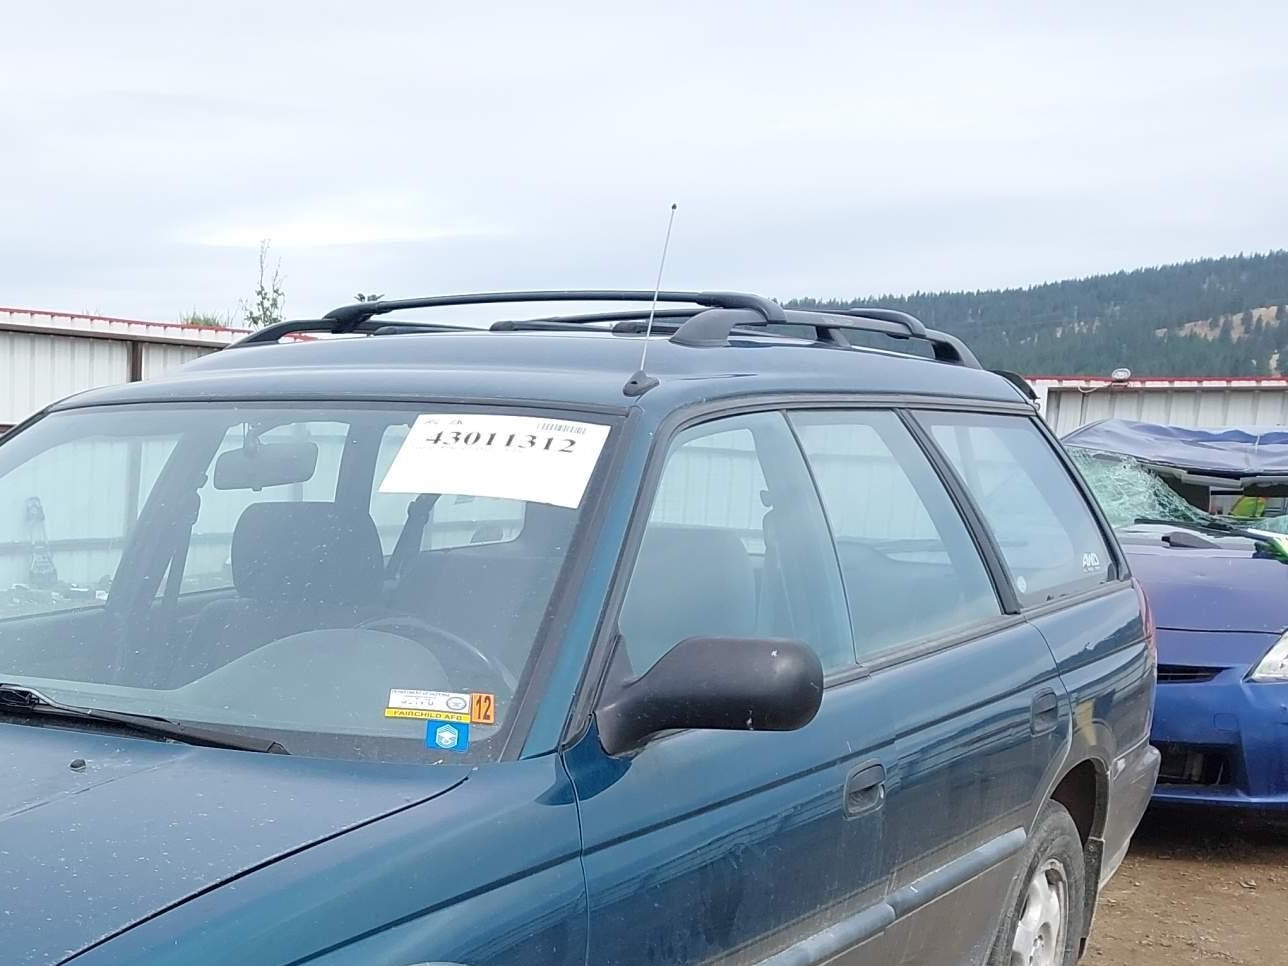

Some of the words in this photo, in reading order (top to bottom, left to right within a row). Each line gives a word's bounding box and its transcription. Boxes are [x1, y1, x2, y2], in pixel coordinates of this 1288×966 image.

[425, 431, 577, 453] 43011312
[393, 710, 442, 719] FAIRCHILD
[475, 695, 491, 721] 12
